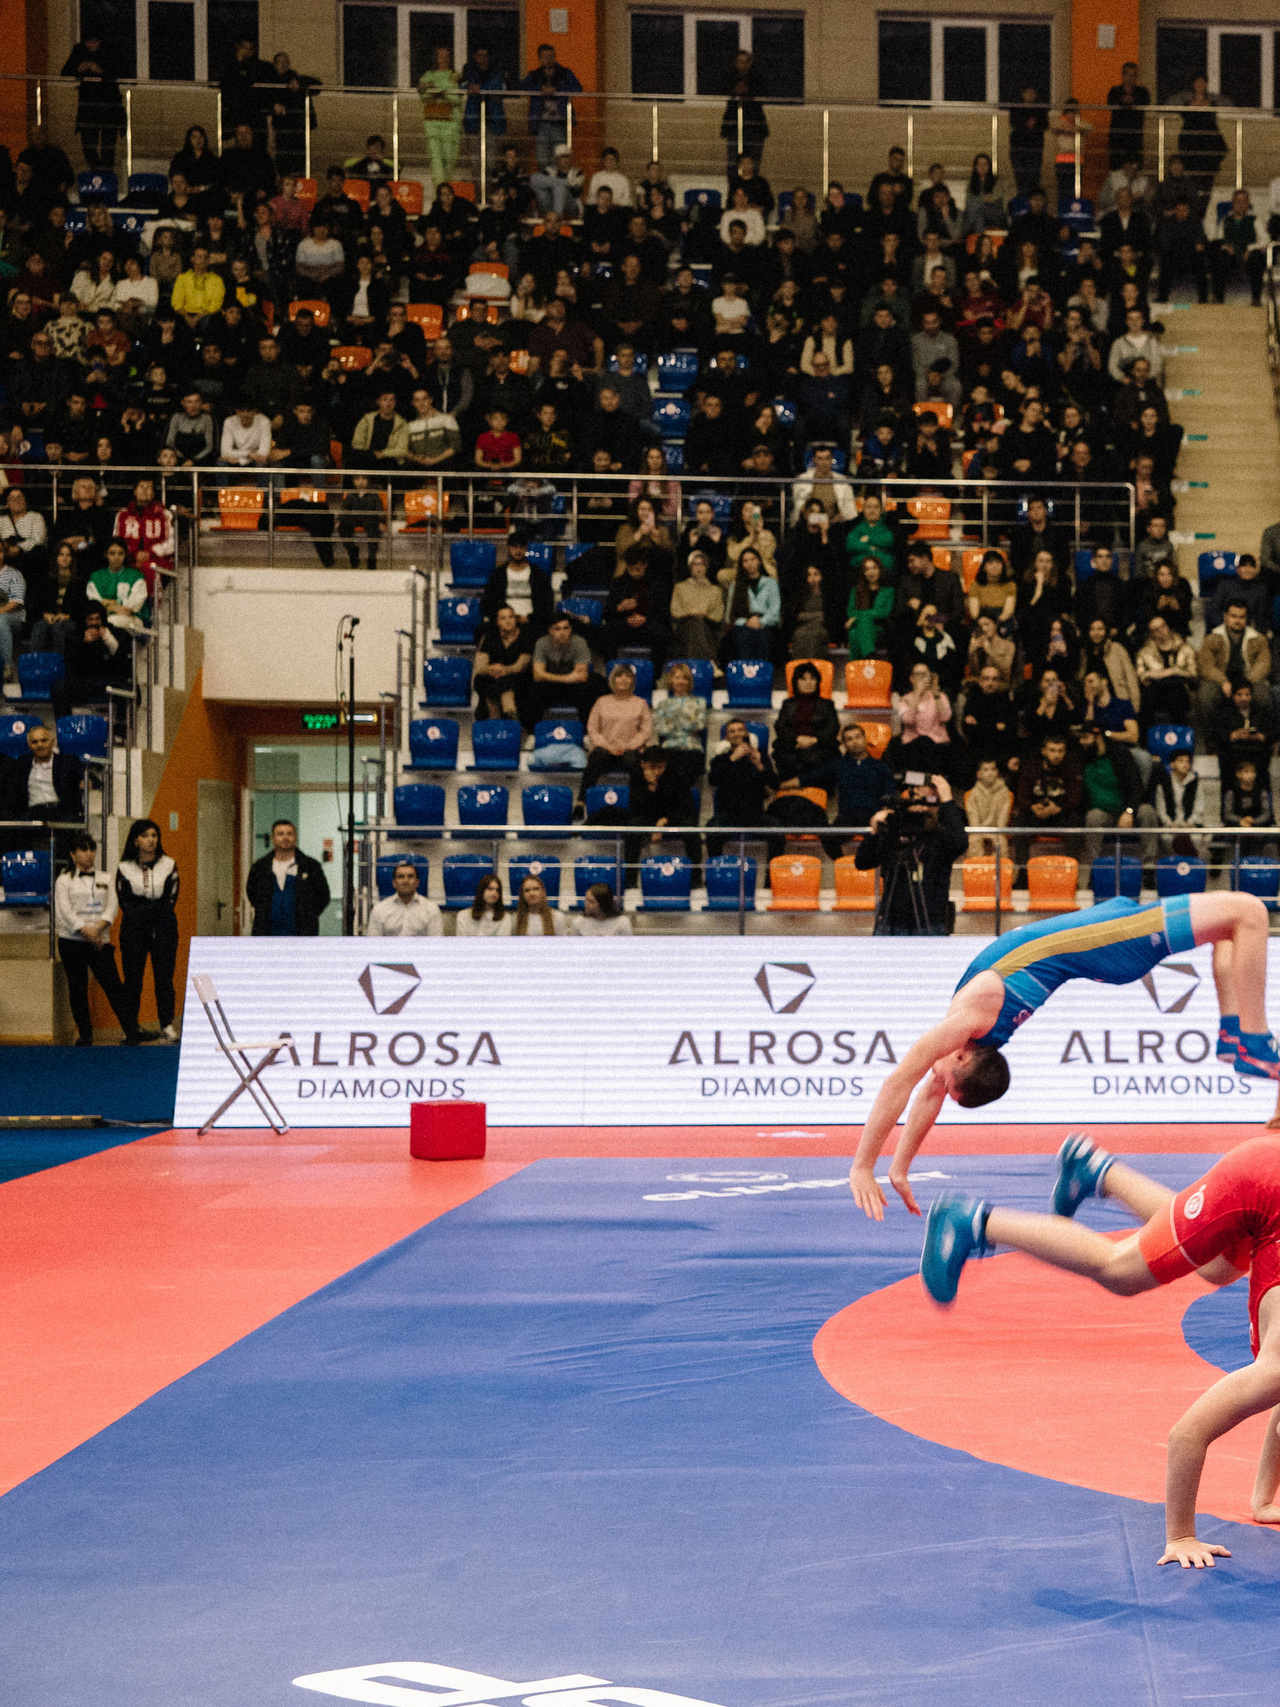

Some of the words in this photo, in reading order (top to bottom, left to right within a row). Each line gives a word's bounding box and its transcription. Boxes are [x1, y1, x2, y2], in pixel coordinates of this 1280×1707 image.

[267, 1031, 502, 1067] ALROSA
[668, 1030, 899, 1065] ALROSA
[1060, 1029, 1212, 1064] ALRO
[297, 1078, 467, 1099] DIAMONDS
[701, 1077, 864, 1097] DIAMONDS
[1093, 1075, 1253, 1095] DIAMONDS
